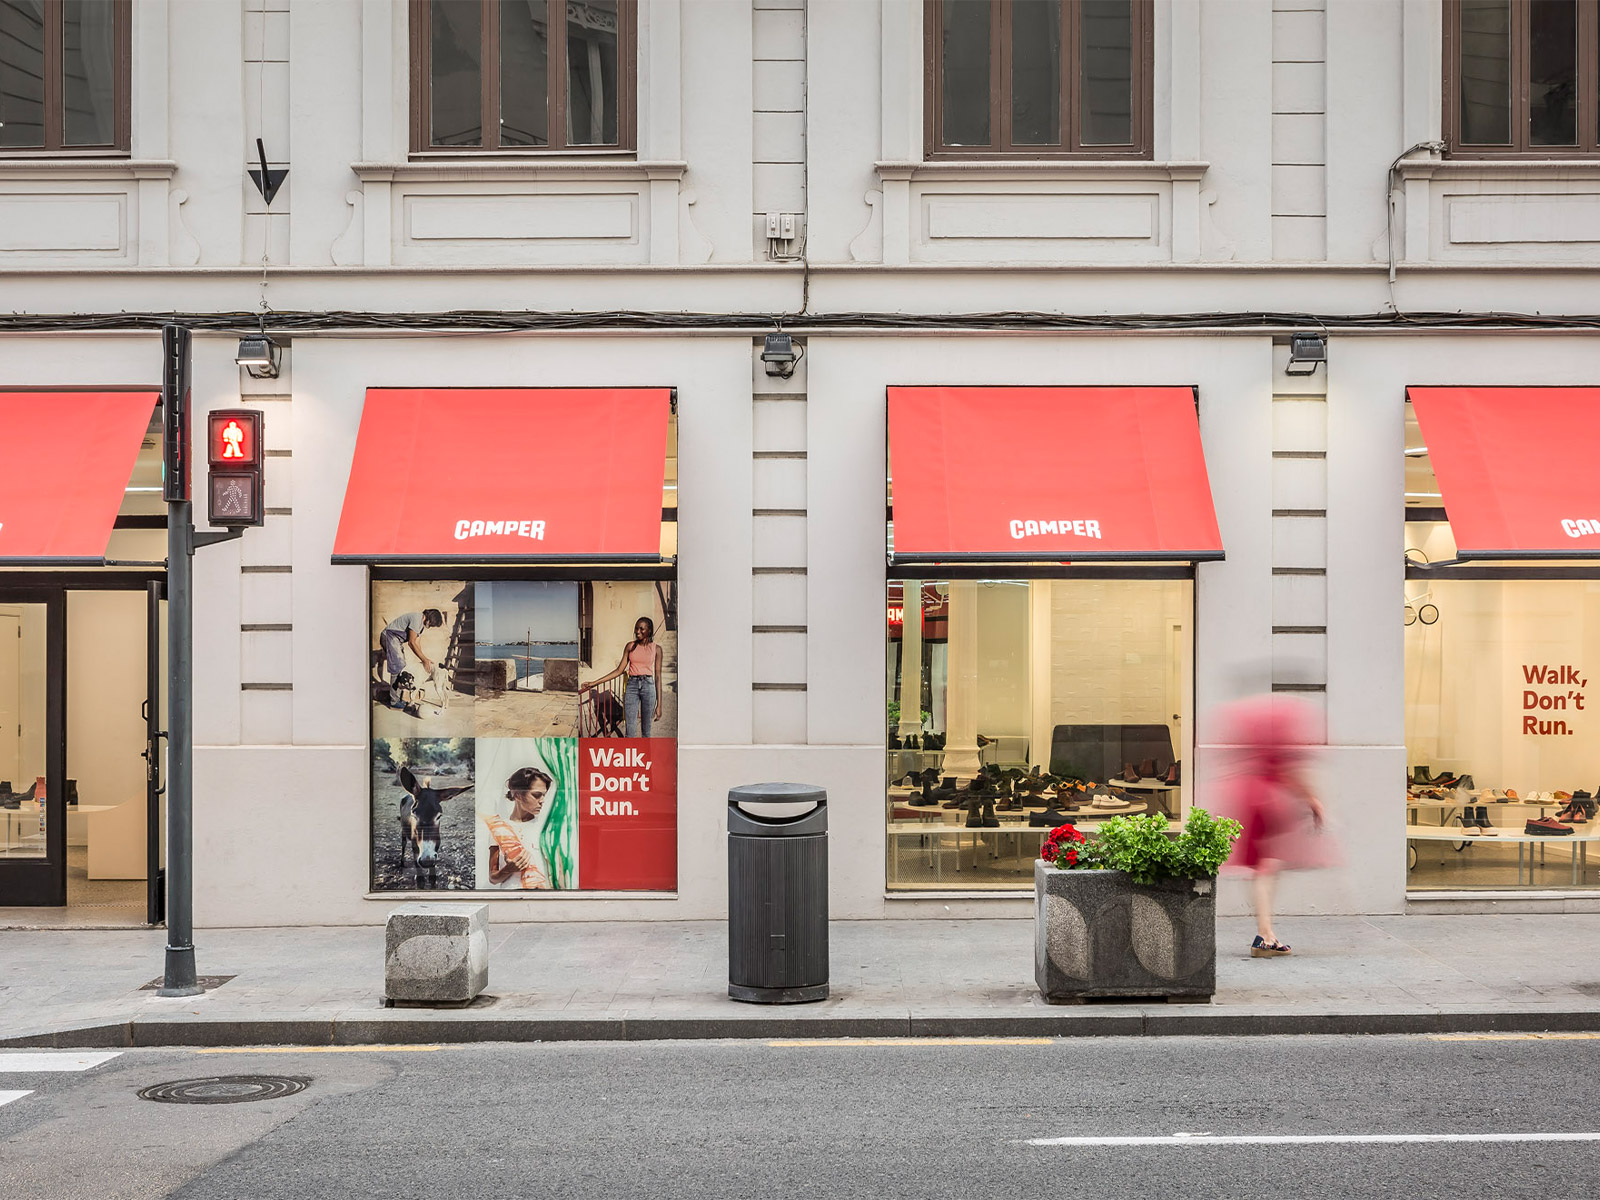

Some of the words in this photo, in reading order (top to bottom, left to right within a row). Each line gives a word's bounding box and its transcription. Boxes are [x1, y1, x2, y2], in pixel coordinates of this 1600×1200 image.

[454, 520, 546, 540] CAMPER
[1009, 519, 1102, 539] CAMPER
[1523, 665, 1588, 688] Walk,
[1523, 690, 1585, 710] Don’t
[1523, 715, 1574, 735] Run.
[589, 748, 652, 770] Walk,
[590, 772, 650, 792] Don’t
[590, 796, 639, 816] Run.
